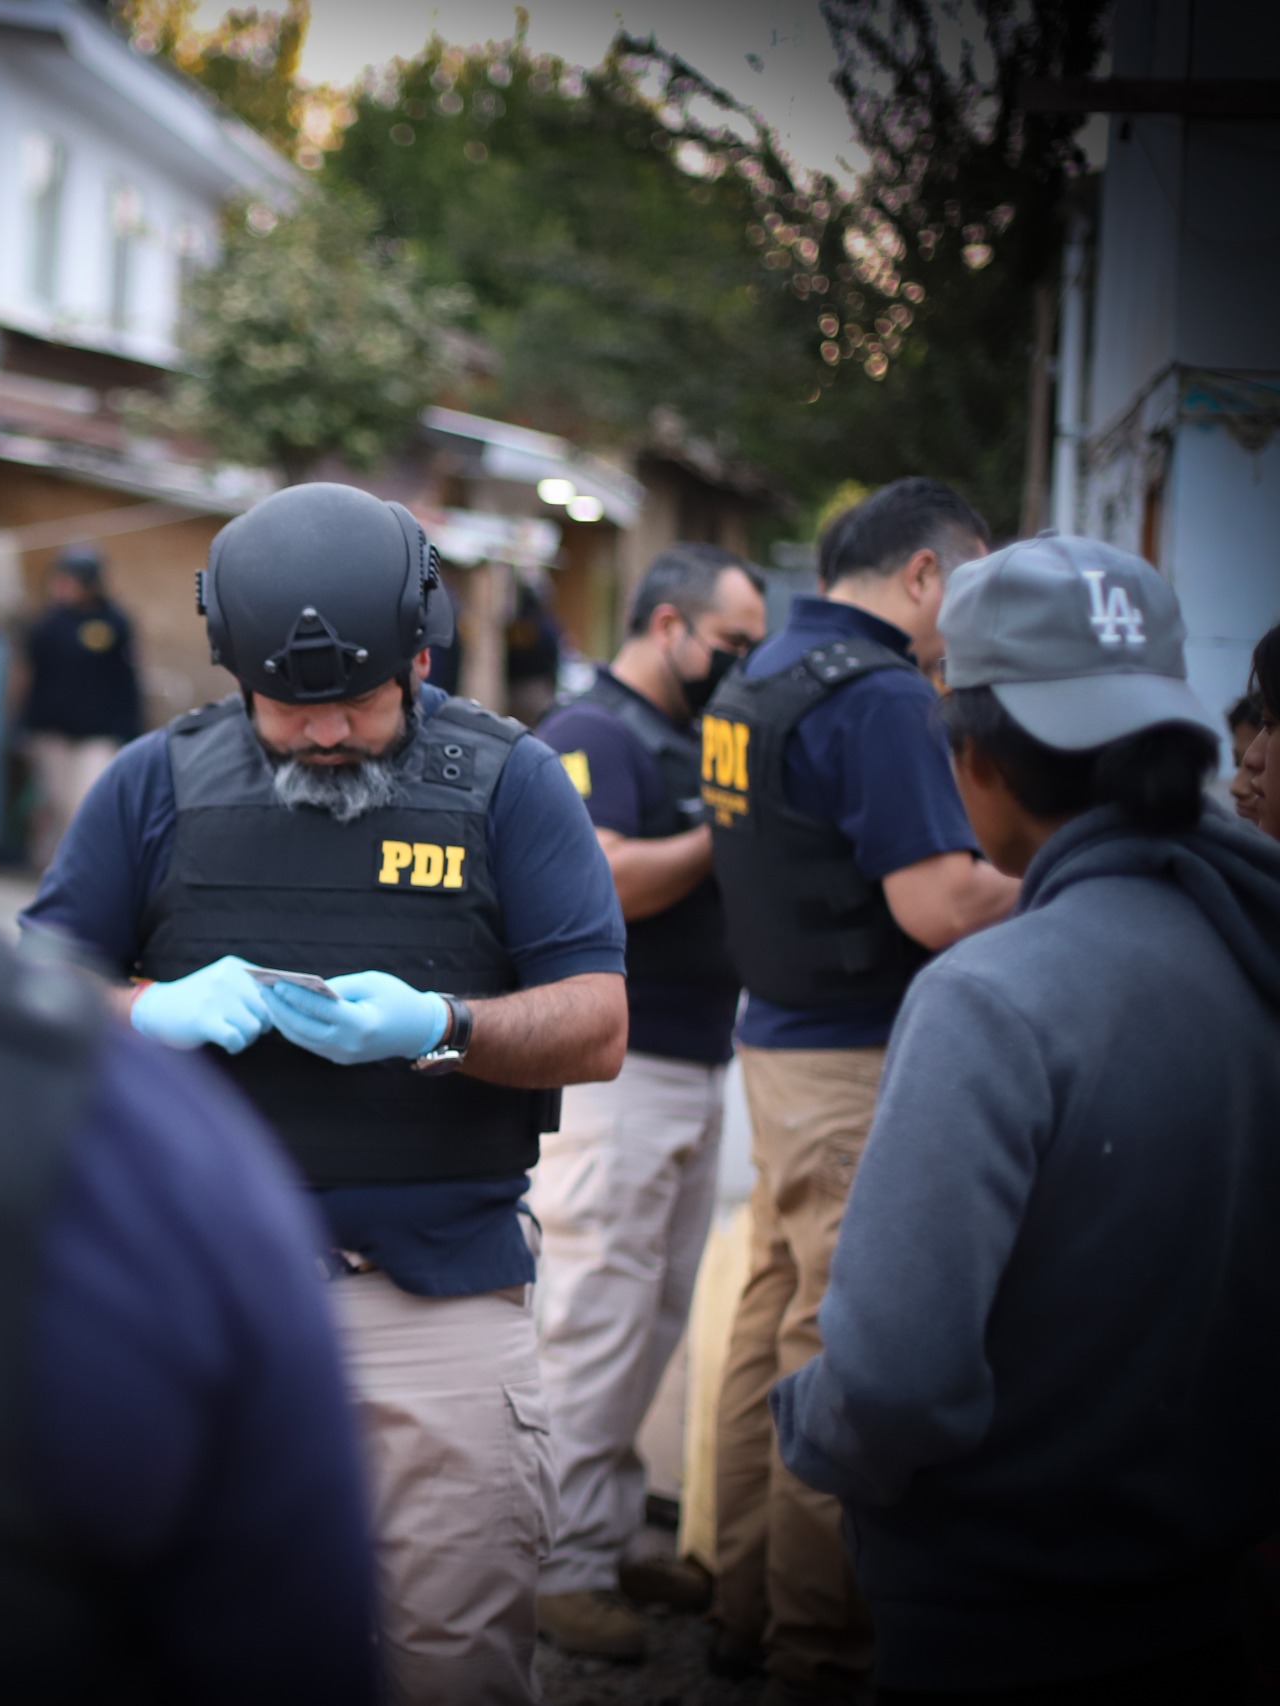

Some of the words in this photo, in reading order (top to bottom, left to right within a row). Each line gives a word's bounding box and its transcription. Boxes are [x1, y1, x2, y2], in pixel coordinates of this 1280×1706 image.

[1081, 570, 1147, 643] LA
[702, 714, 750, 792] PDI
[379, 840, 465, 888] PDI
